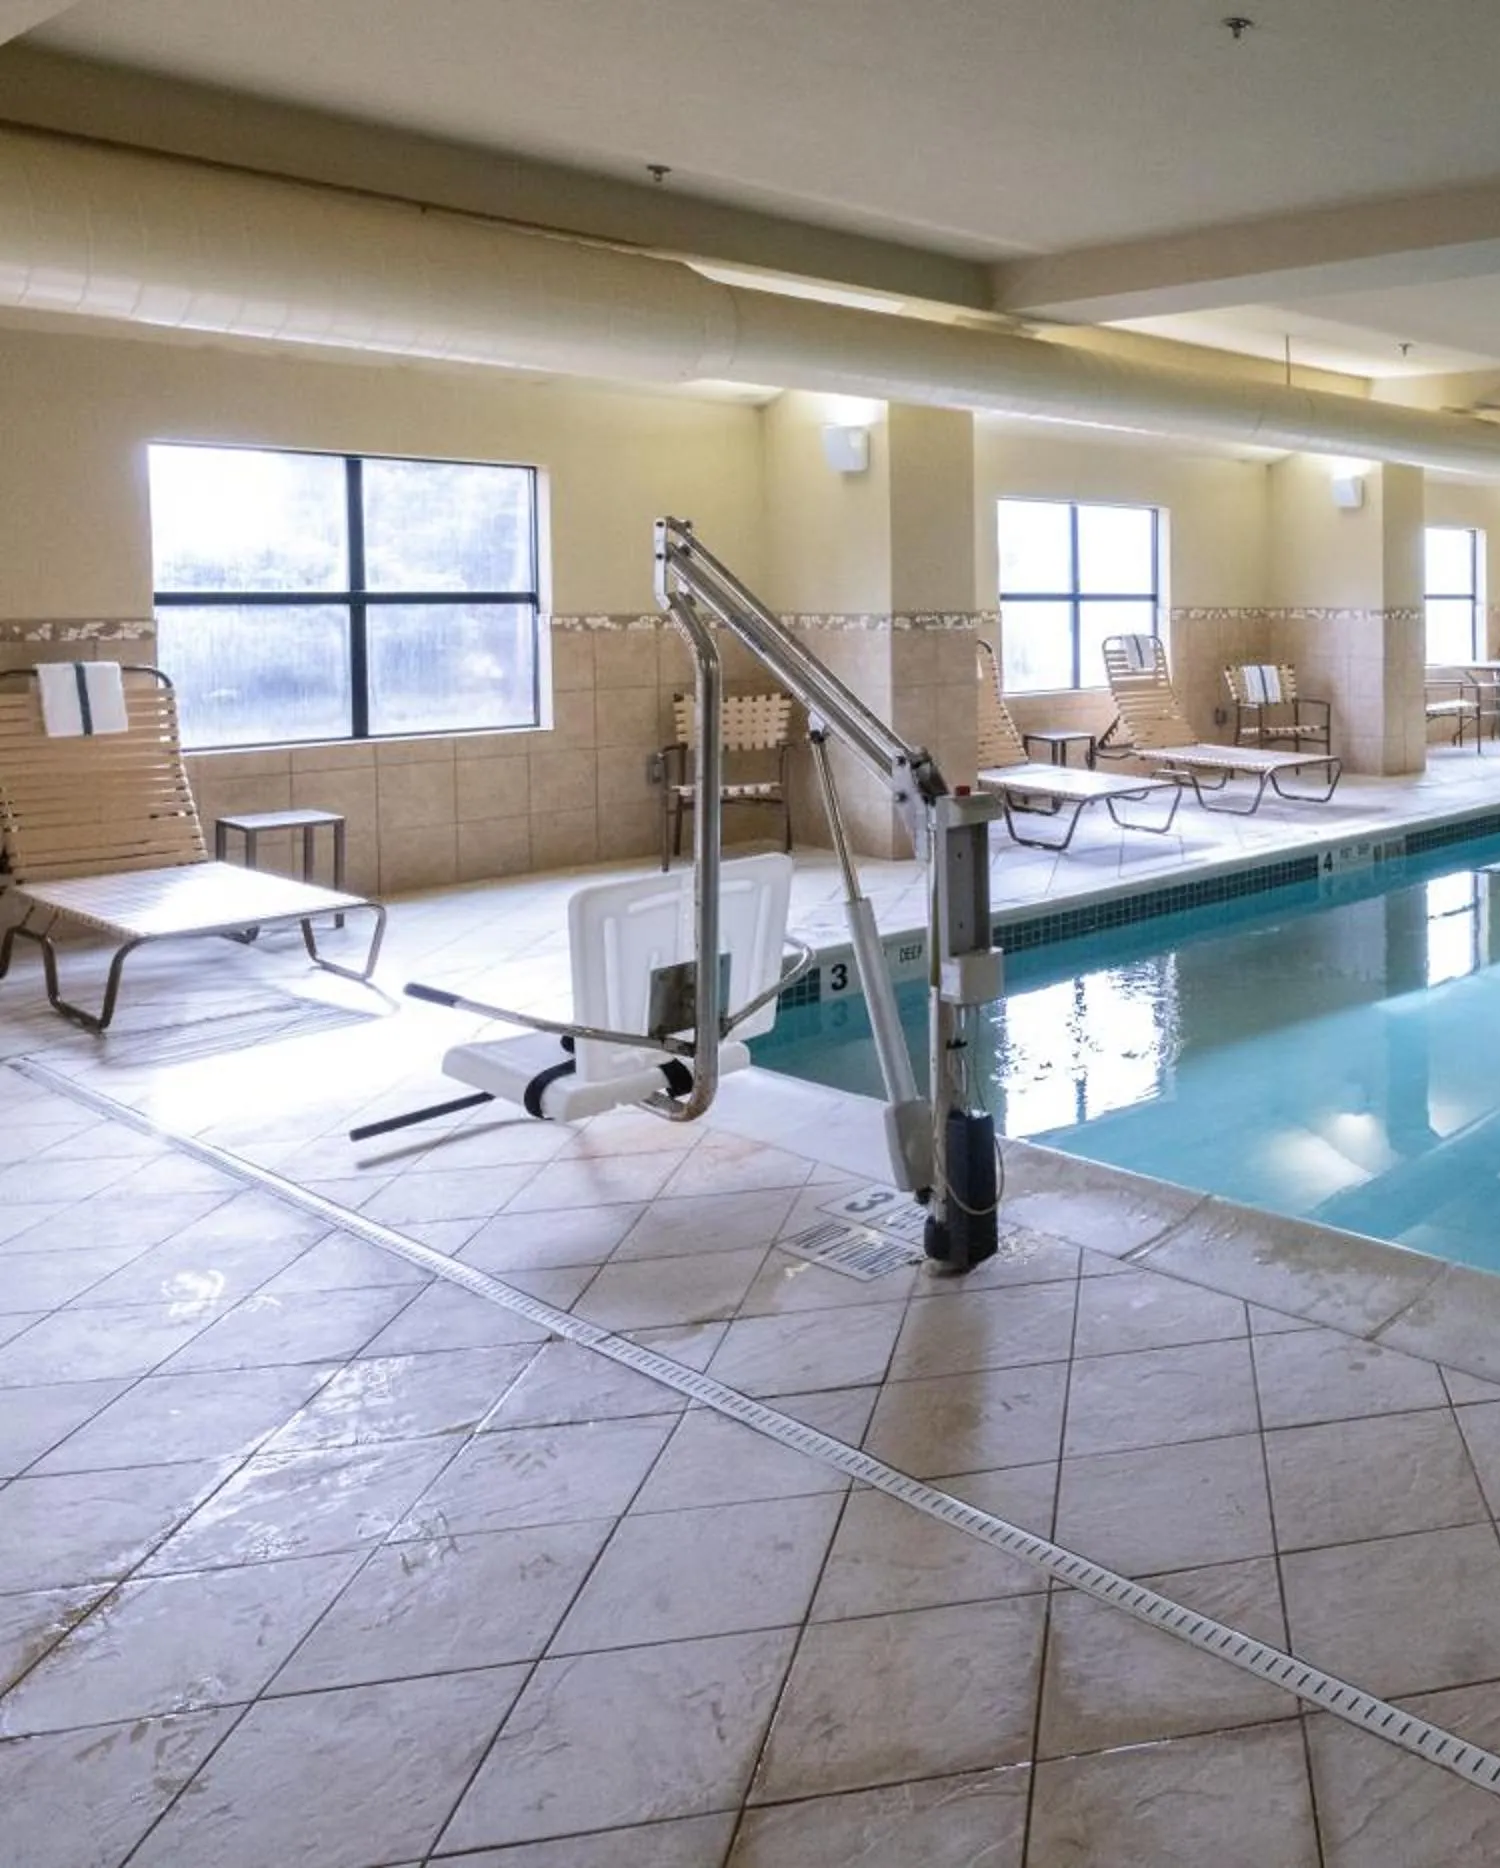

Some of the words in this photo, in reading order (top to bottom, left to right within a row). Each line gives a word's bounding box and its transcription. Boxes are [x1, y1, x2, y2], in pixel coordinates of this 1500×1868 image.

[1323, 851, 1334, 872] 4
[831, 963, 848, 990] 3
[899, 944, 922, 963] DEEP
[845, 1191, 895, 1212] 3
